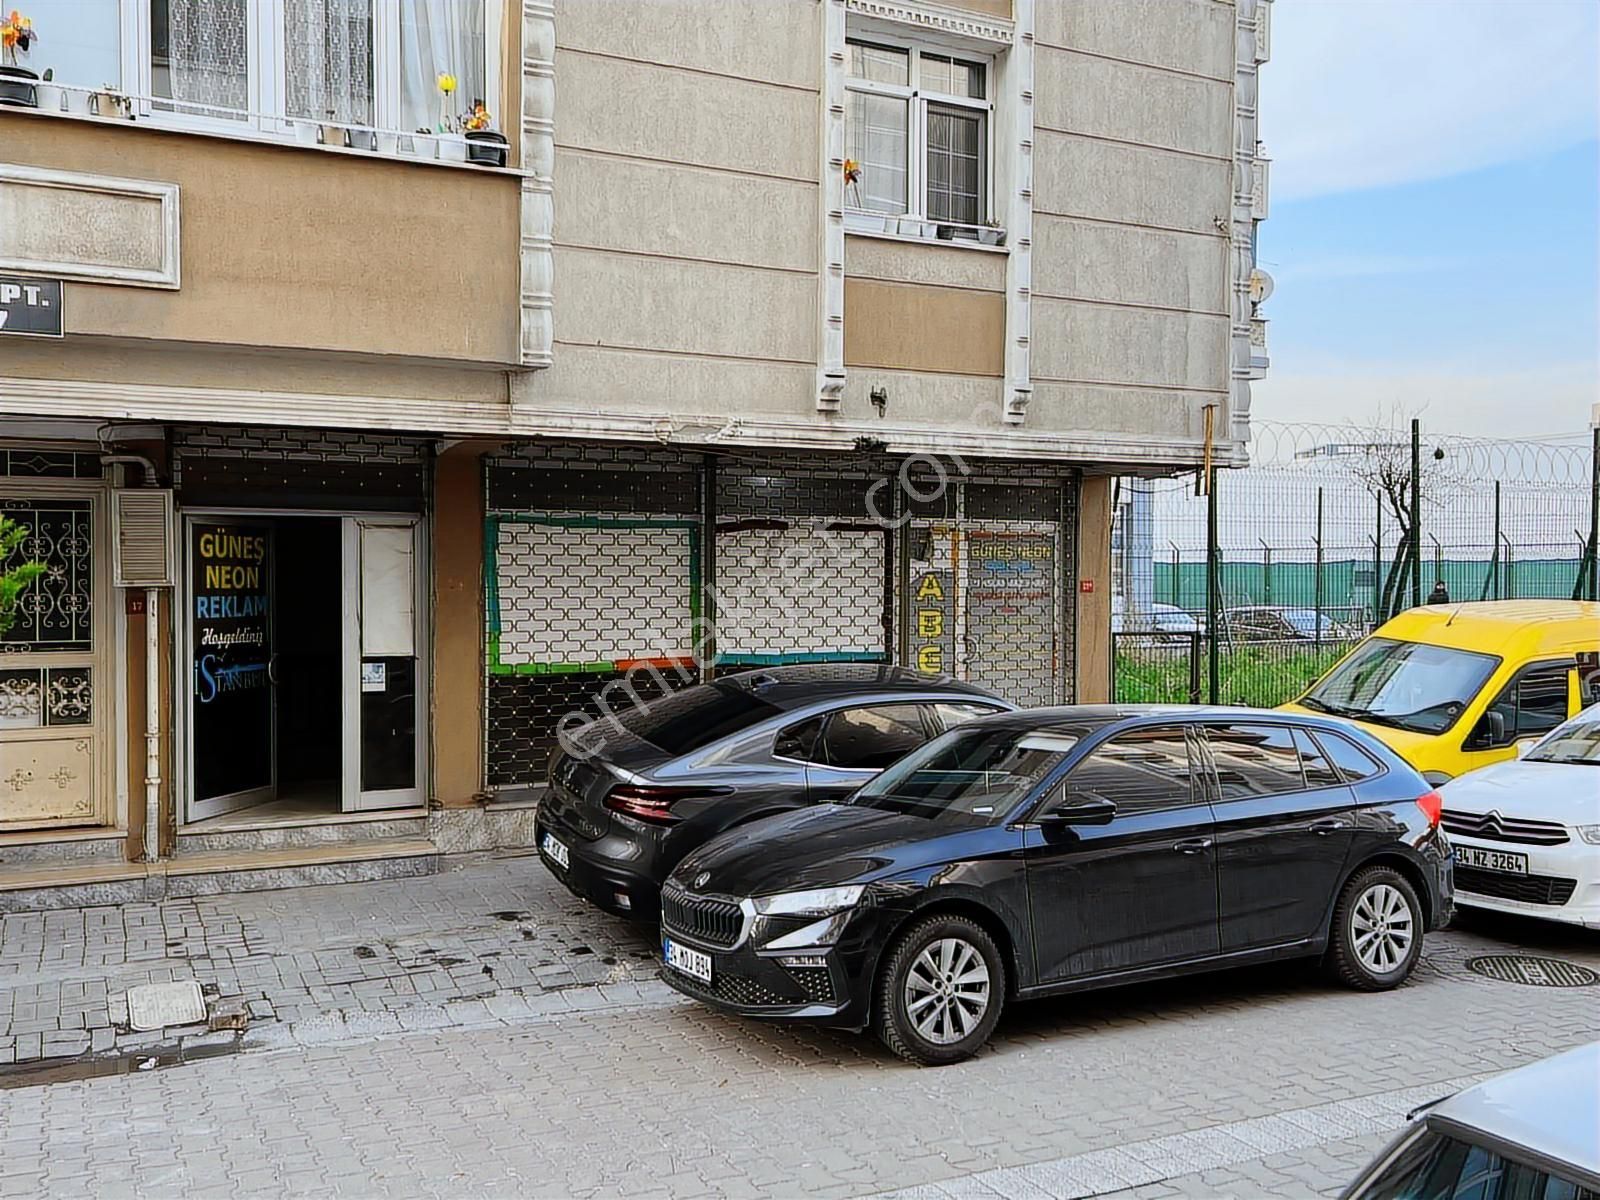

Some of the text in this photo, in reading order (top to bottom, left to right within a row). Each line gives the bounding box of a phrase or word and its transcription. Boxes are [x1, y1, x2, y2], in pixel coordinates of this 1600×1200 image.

[200, 528, 264, 565] GÜNEŞ
[206, 565, 259, 589] NEON
[132, 601, 143, 611] 17
[197, 595, 268, 618] REKLAM
[1491, 853, 1522, 871] 3264
